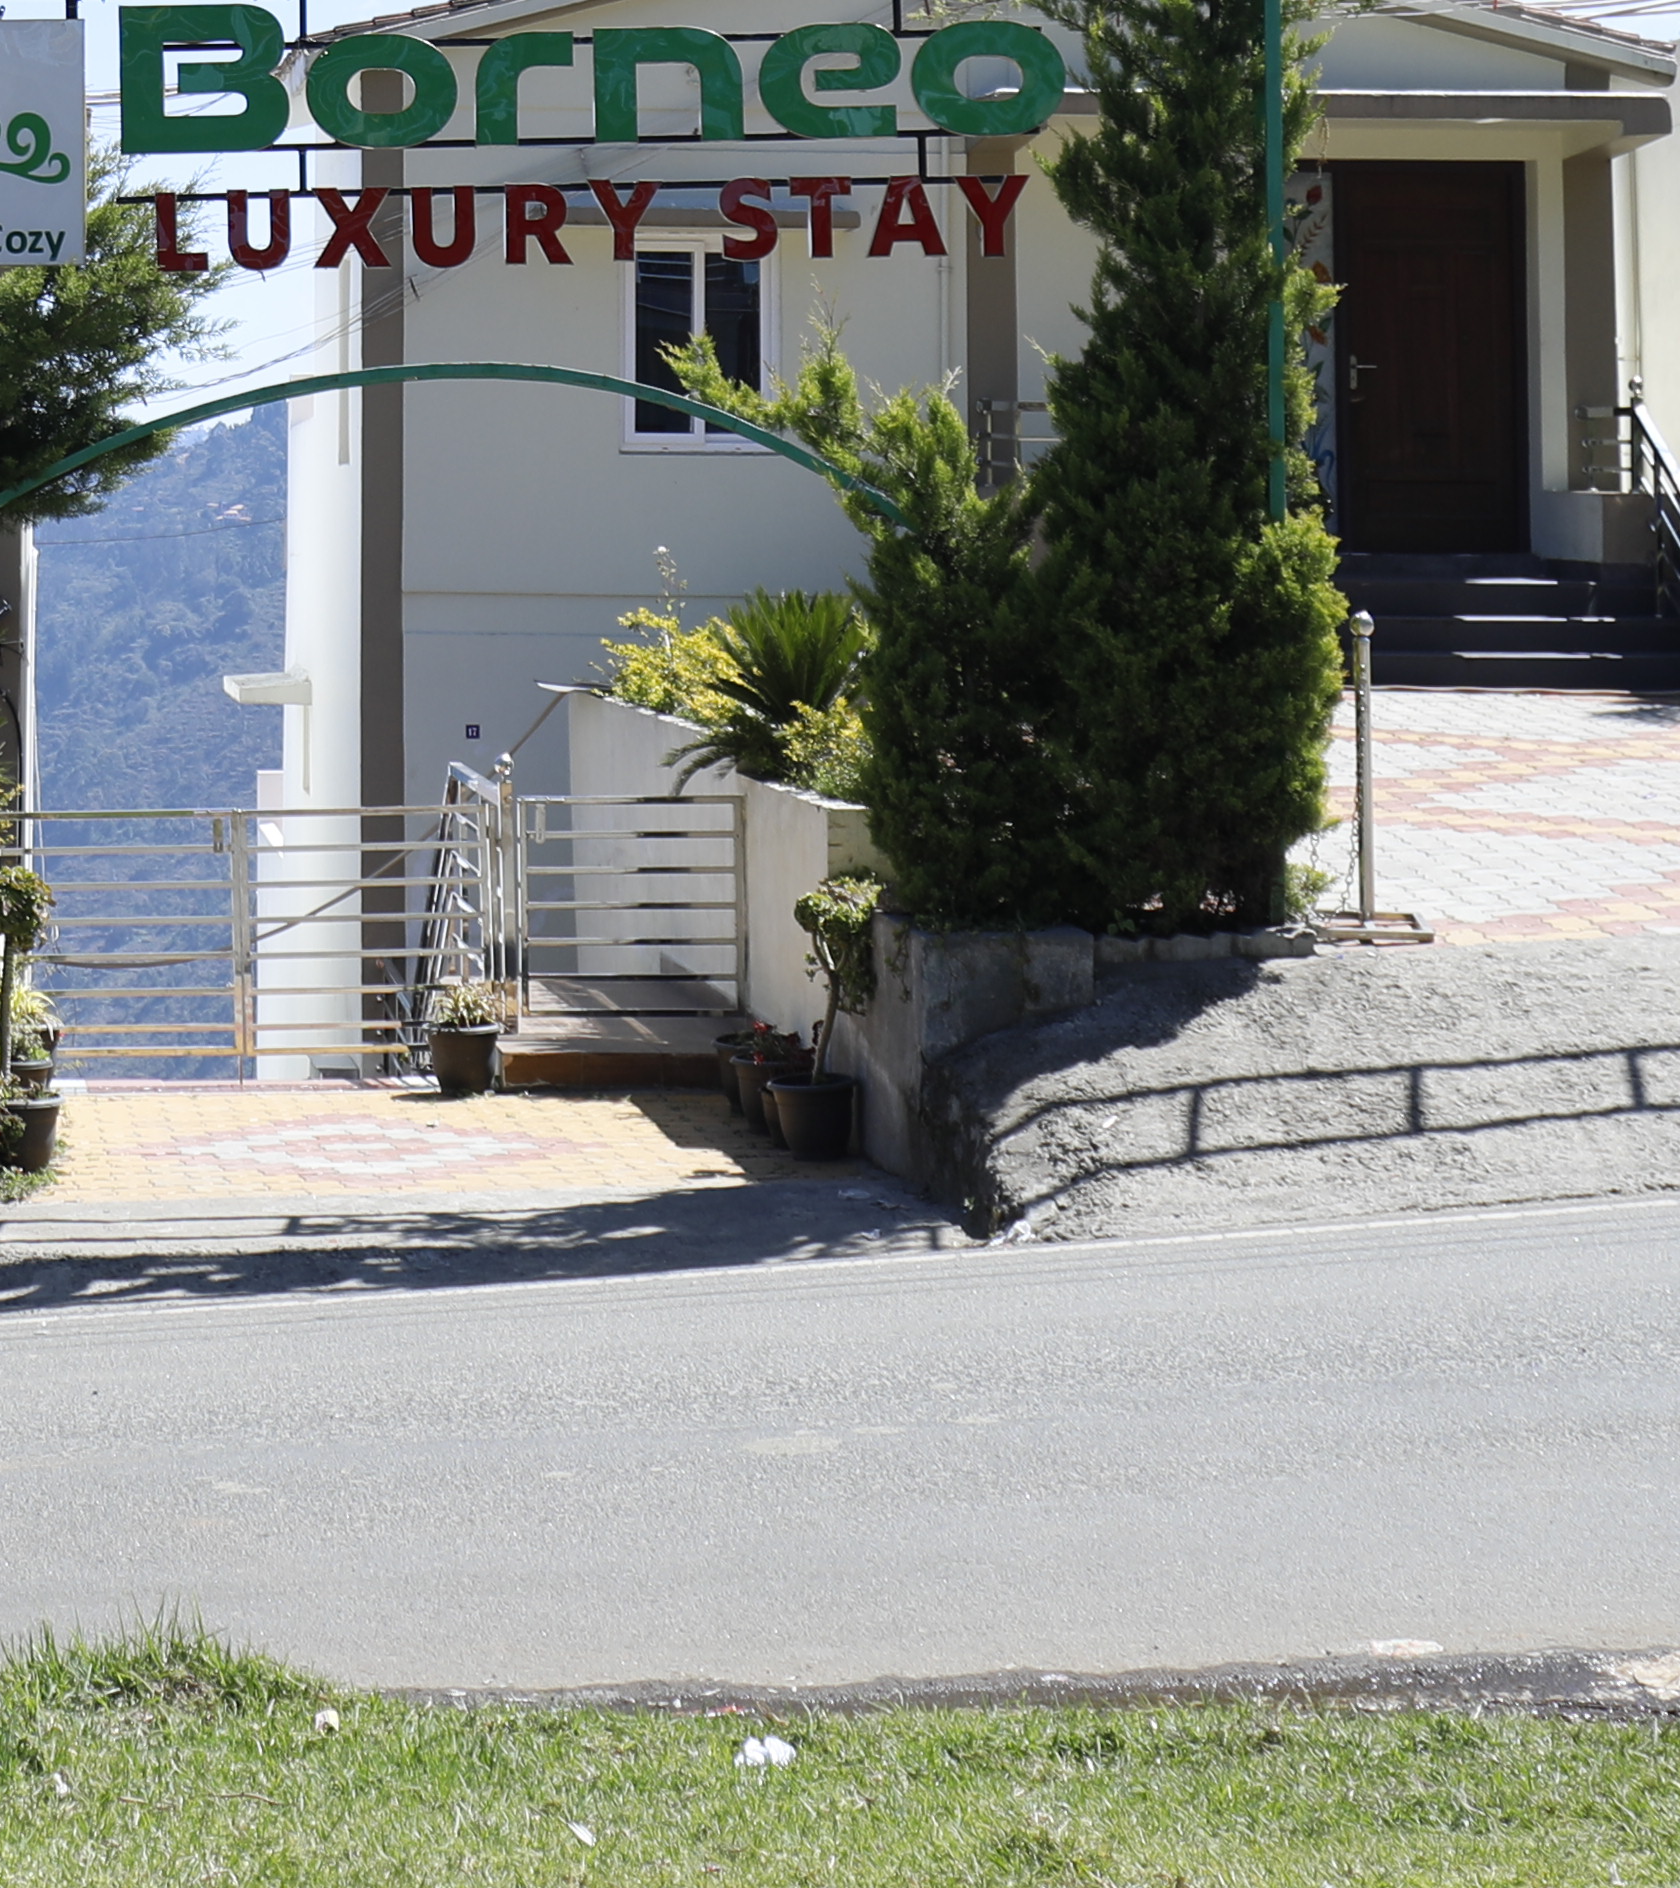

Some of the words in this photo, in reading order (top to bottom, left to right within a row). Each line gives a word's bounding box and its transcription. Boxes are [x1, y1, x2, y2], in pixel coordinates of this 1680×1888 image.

[119, 3, 1066, 155] Borneo
[156, 178, 662, 273] LUXURY
[717, 173, 1029, 262] STAY
